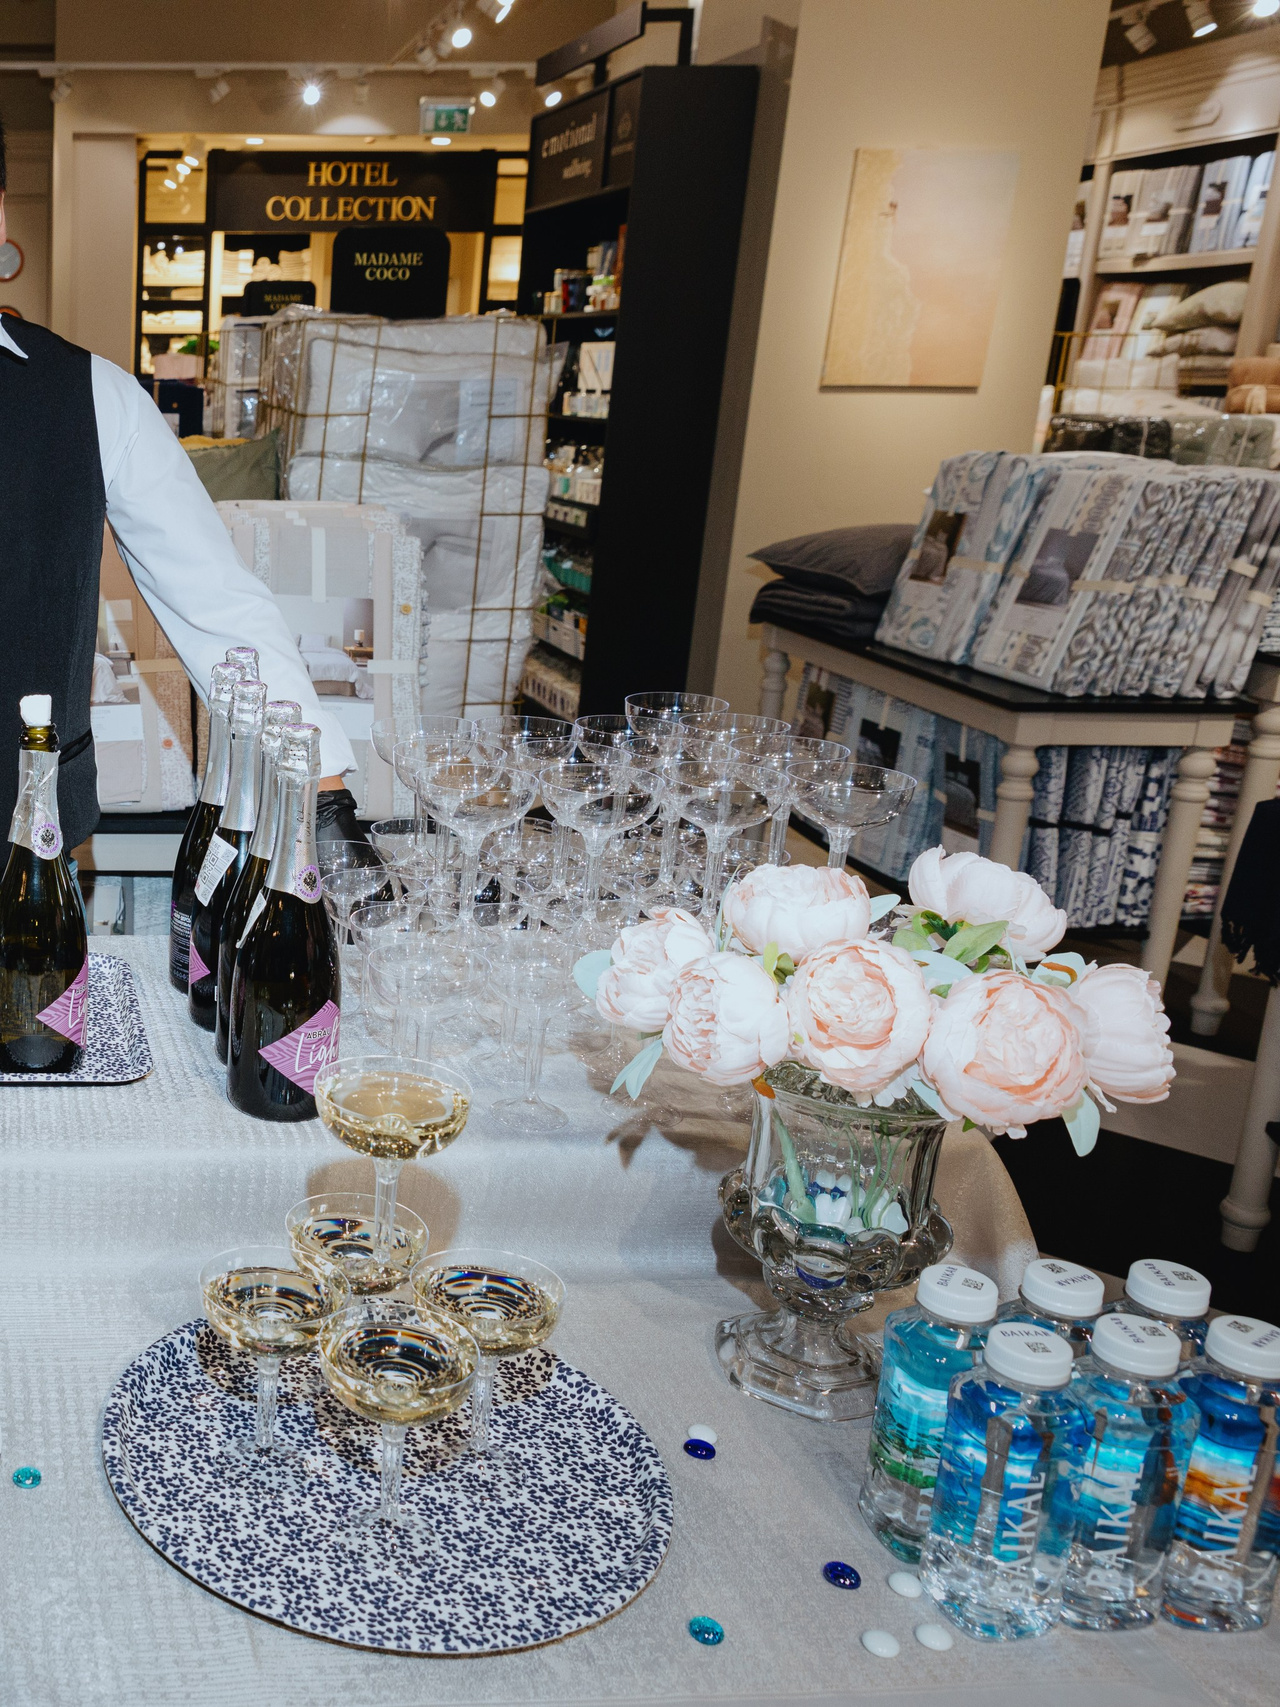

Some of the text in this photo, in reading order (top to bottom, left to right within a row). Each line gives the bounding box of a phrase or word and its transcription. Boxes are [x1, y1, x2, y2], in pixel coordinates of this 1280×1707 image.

[306, 160, 398, 187] HOTEL
[265, 195, 437, 221] COLLECTION
[354, 252, 423, 267] MADAME
[365, 267, 410, 281] COCO
[992, 1471, 1046, 1597] BAIKAL
[1086, 1463, 1145, 1600] BAIKAL
[1191, 1464, 1258, 1602] BAIKAL
